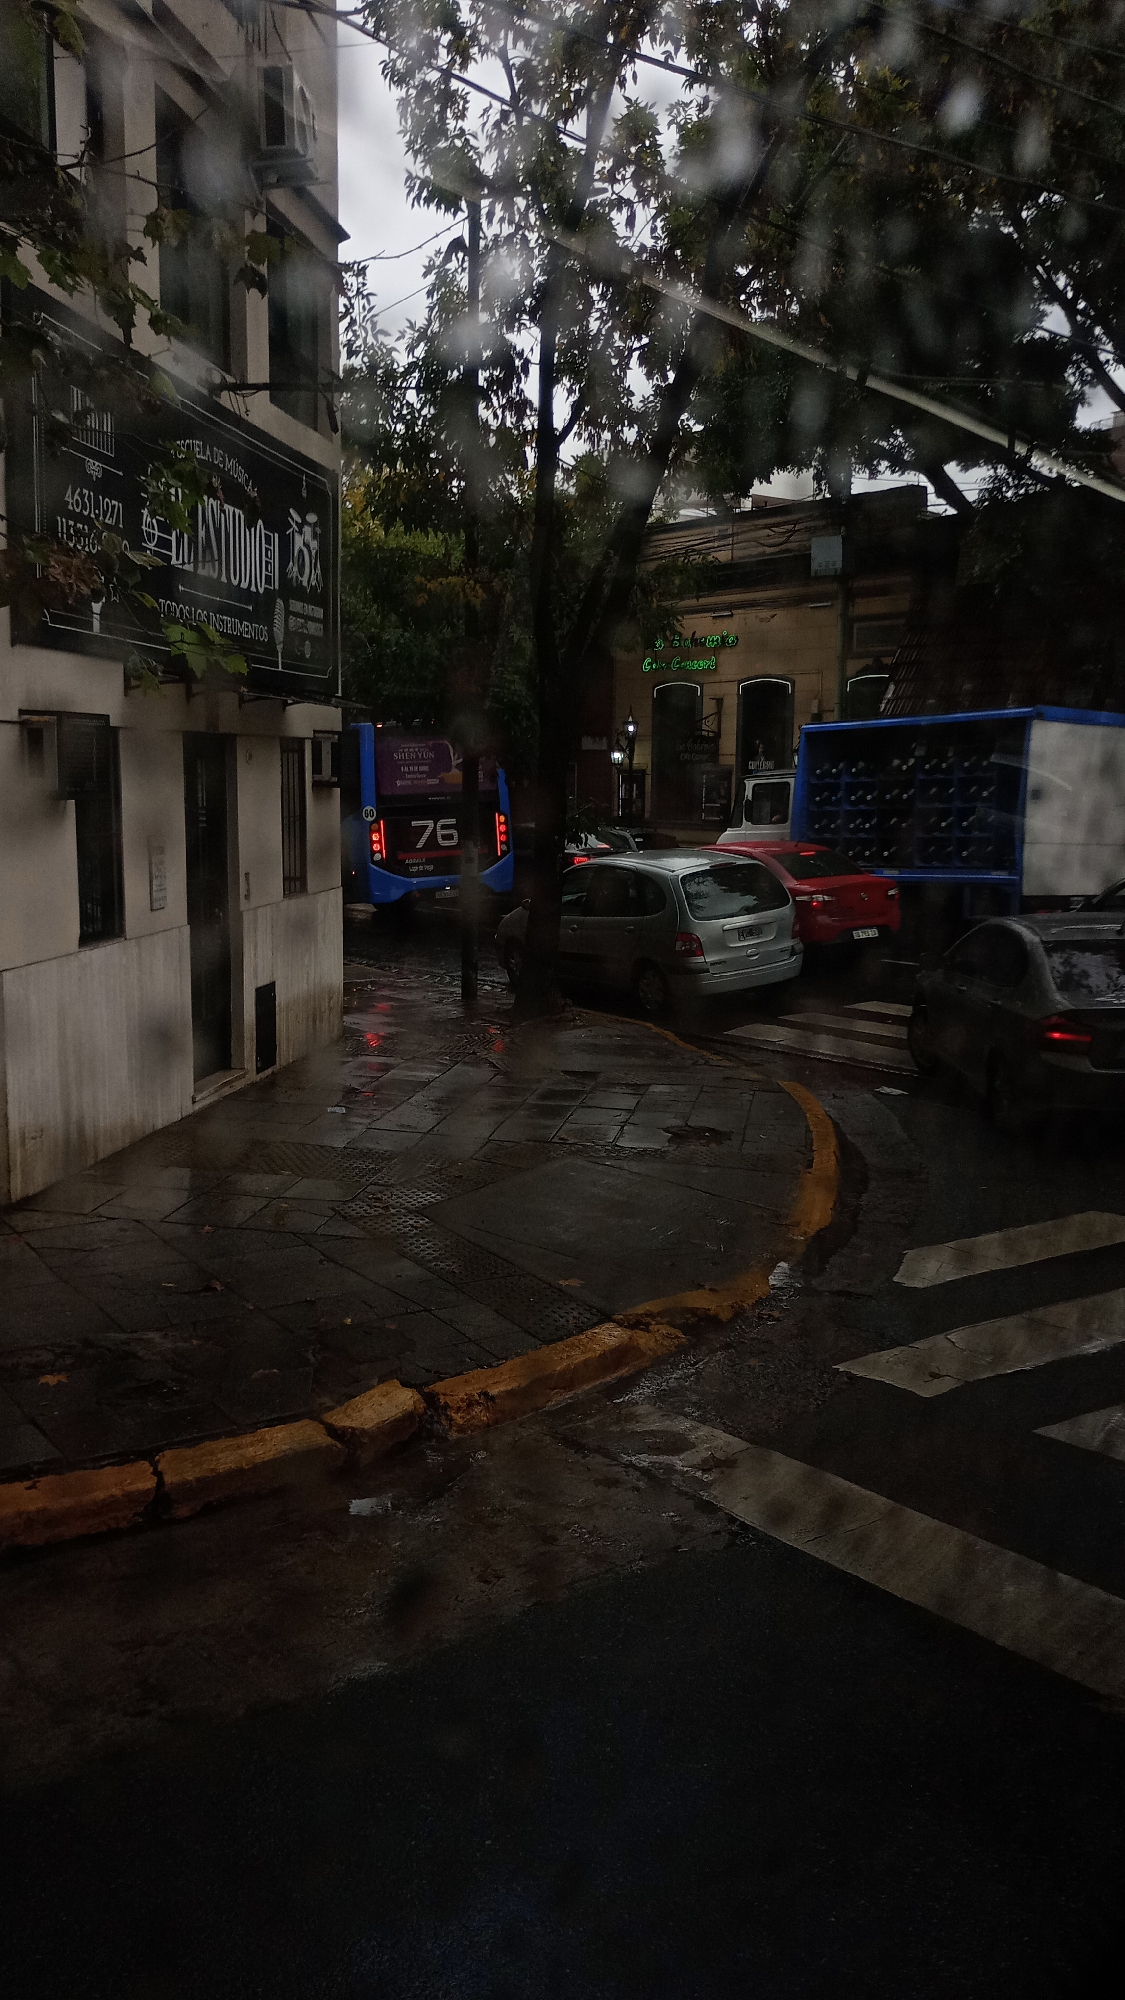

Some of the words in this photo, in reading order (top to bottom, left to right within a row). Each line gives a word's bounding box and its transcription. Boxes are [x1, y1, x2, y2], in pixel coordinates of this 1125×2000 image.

[213, 447, 224, 468] DE
[210, 612, 269, 643] INSTRUMENTOS
[393, 752, 416, 760] SHEN
[417, 751, 435, 759] YUN
[411, 818, 459, 849] 76
